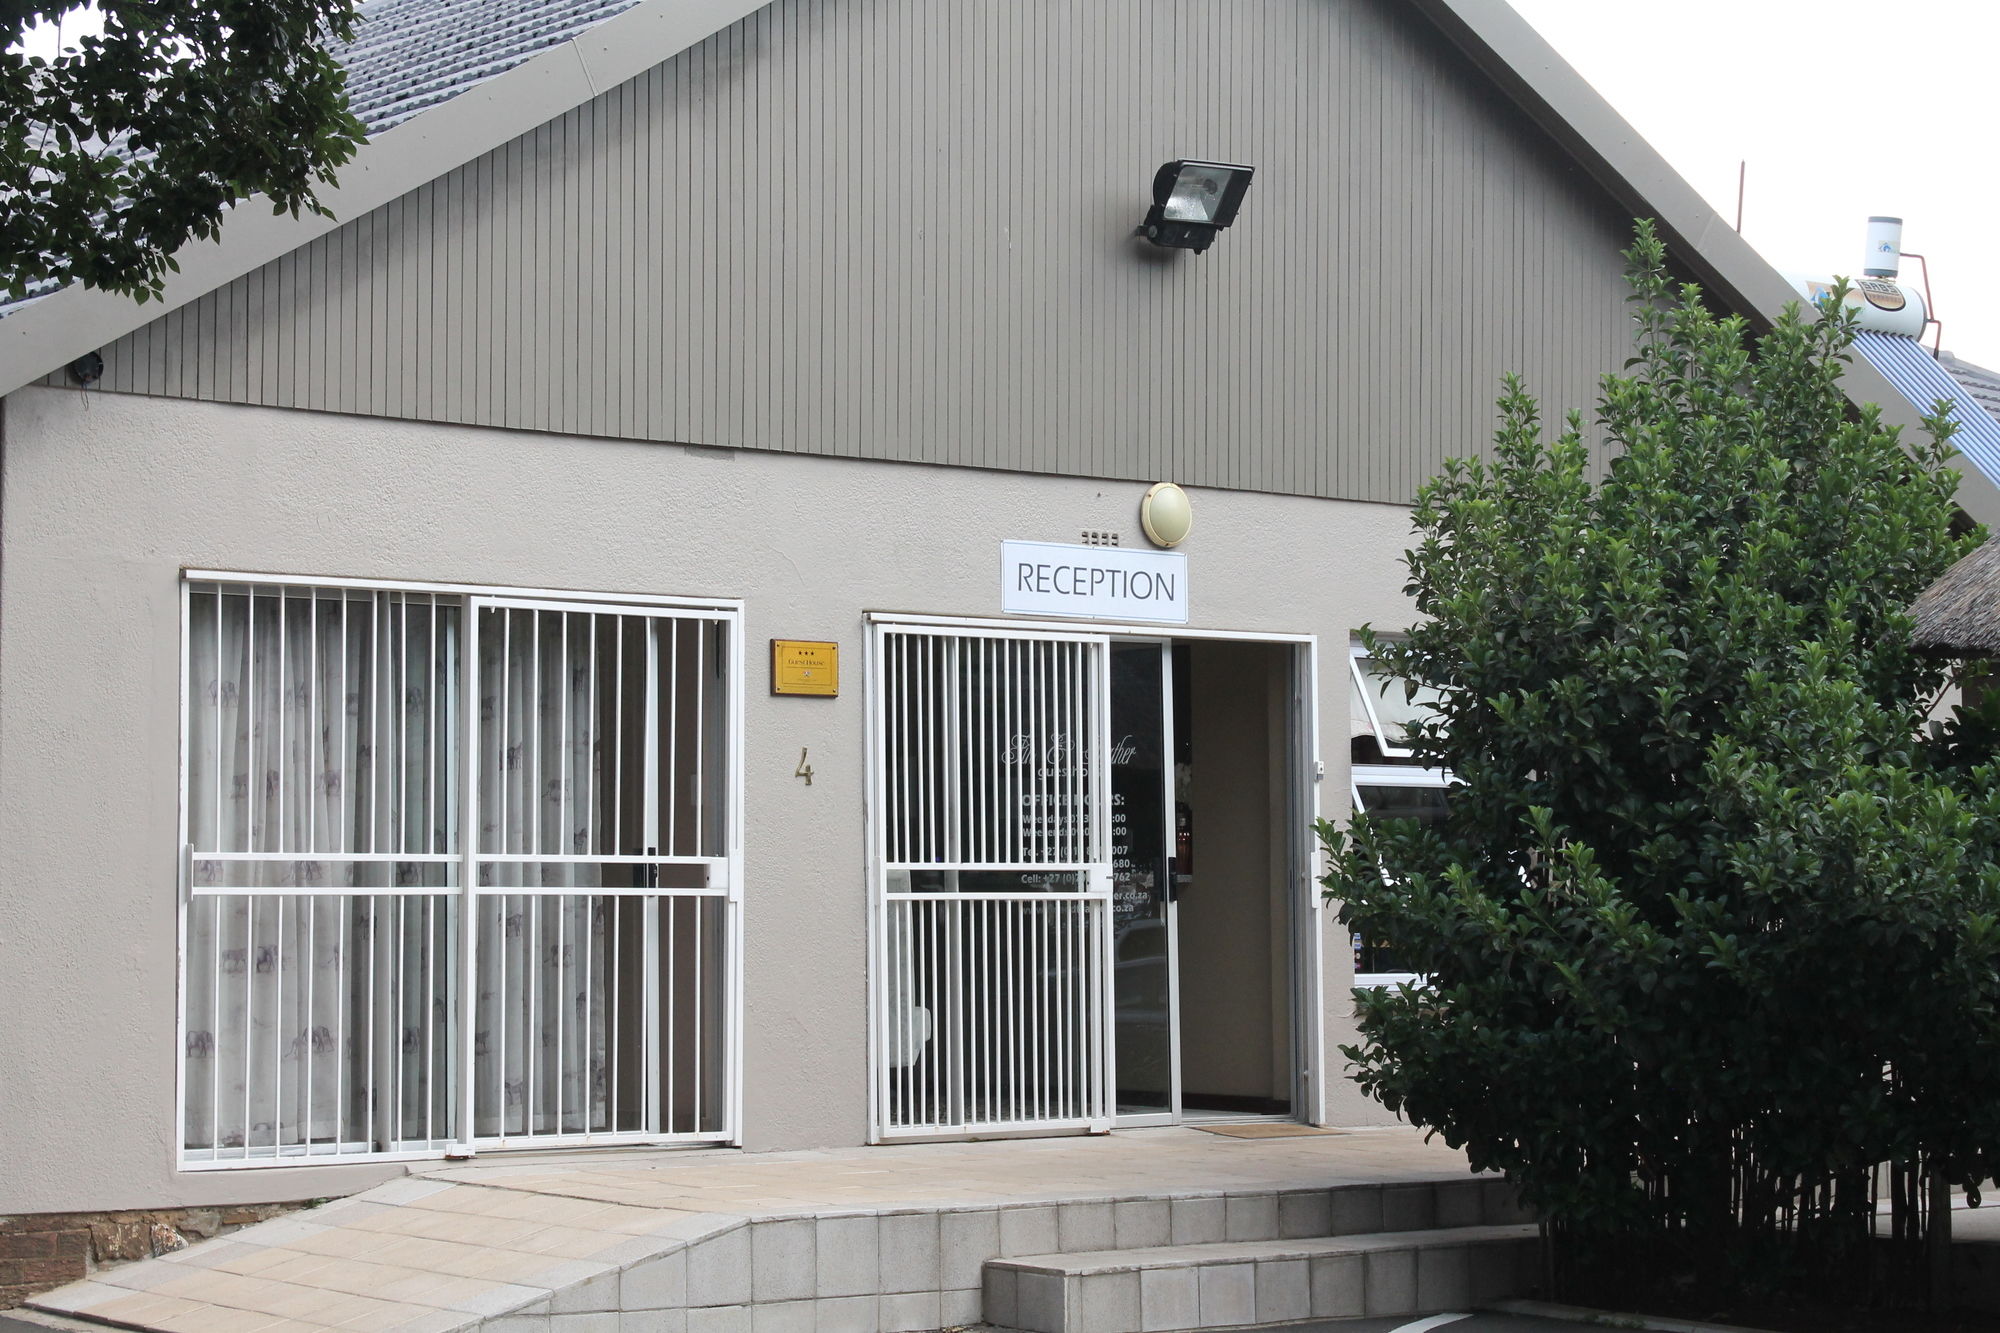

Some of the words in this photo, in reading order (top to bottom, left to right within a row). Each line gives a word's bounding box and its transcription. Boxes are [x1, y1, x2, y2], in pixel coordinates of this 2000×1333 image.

[1018, 562, 1175, 601] RECEPTION
[795, 747, 814, 786] 4
[1073, 793, 1125, 806] HOS:
[1021, 873, 1041, 883] Cell:
